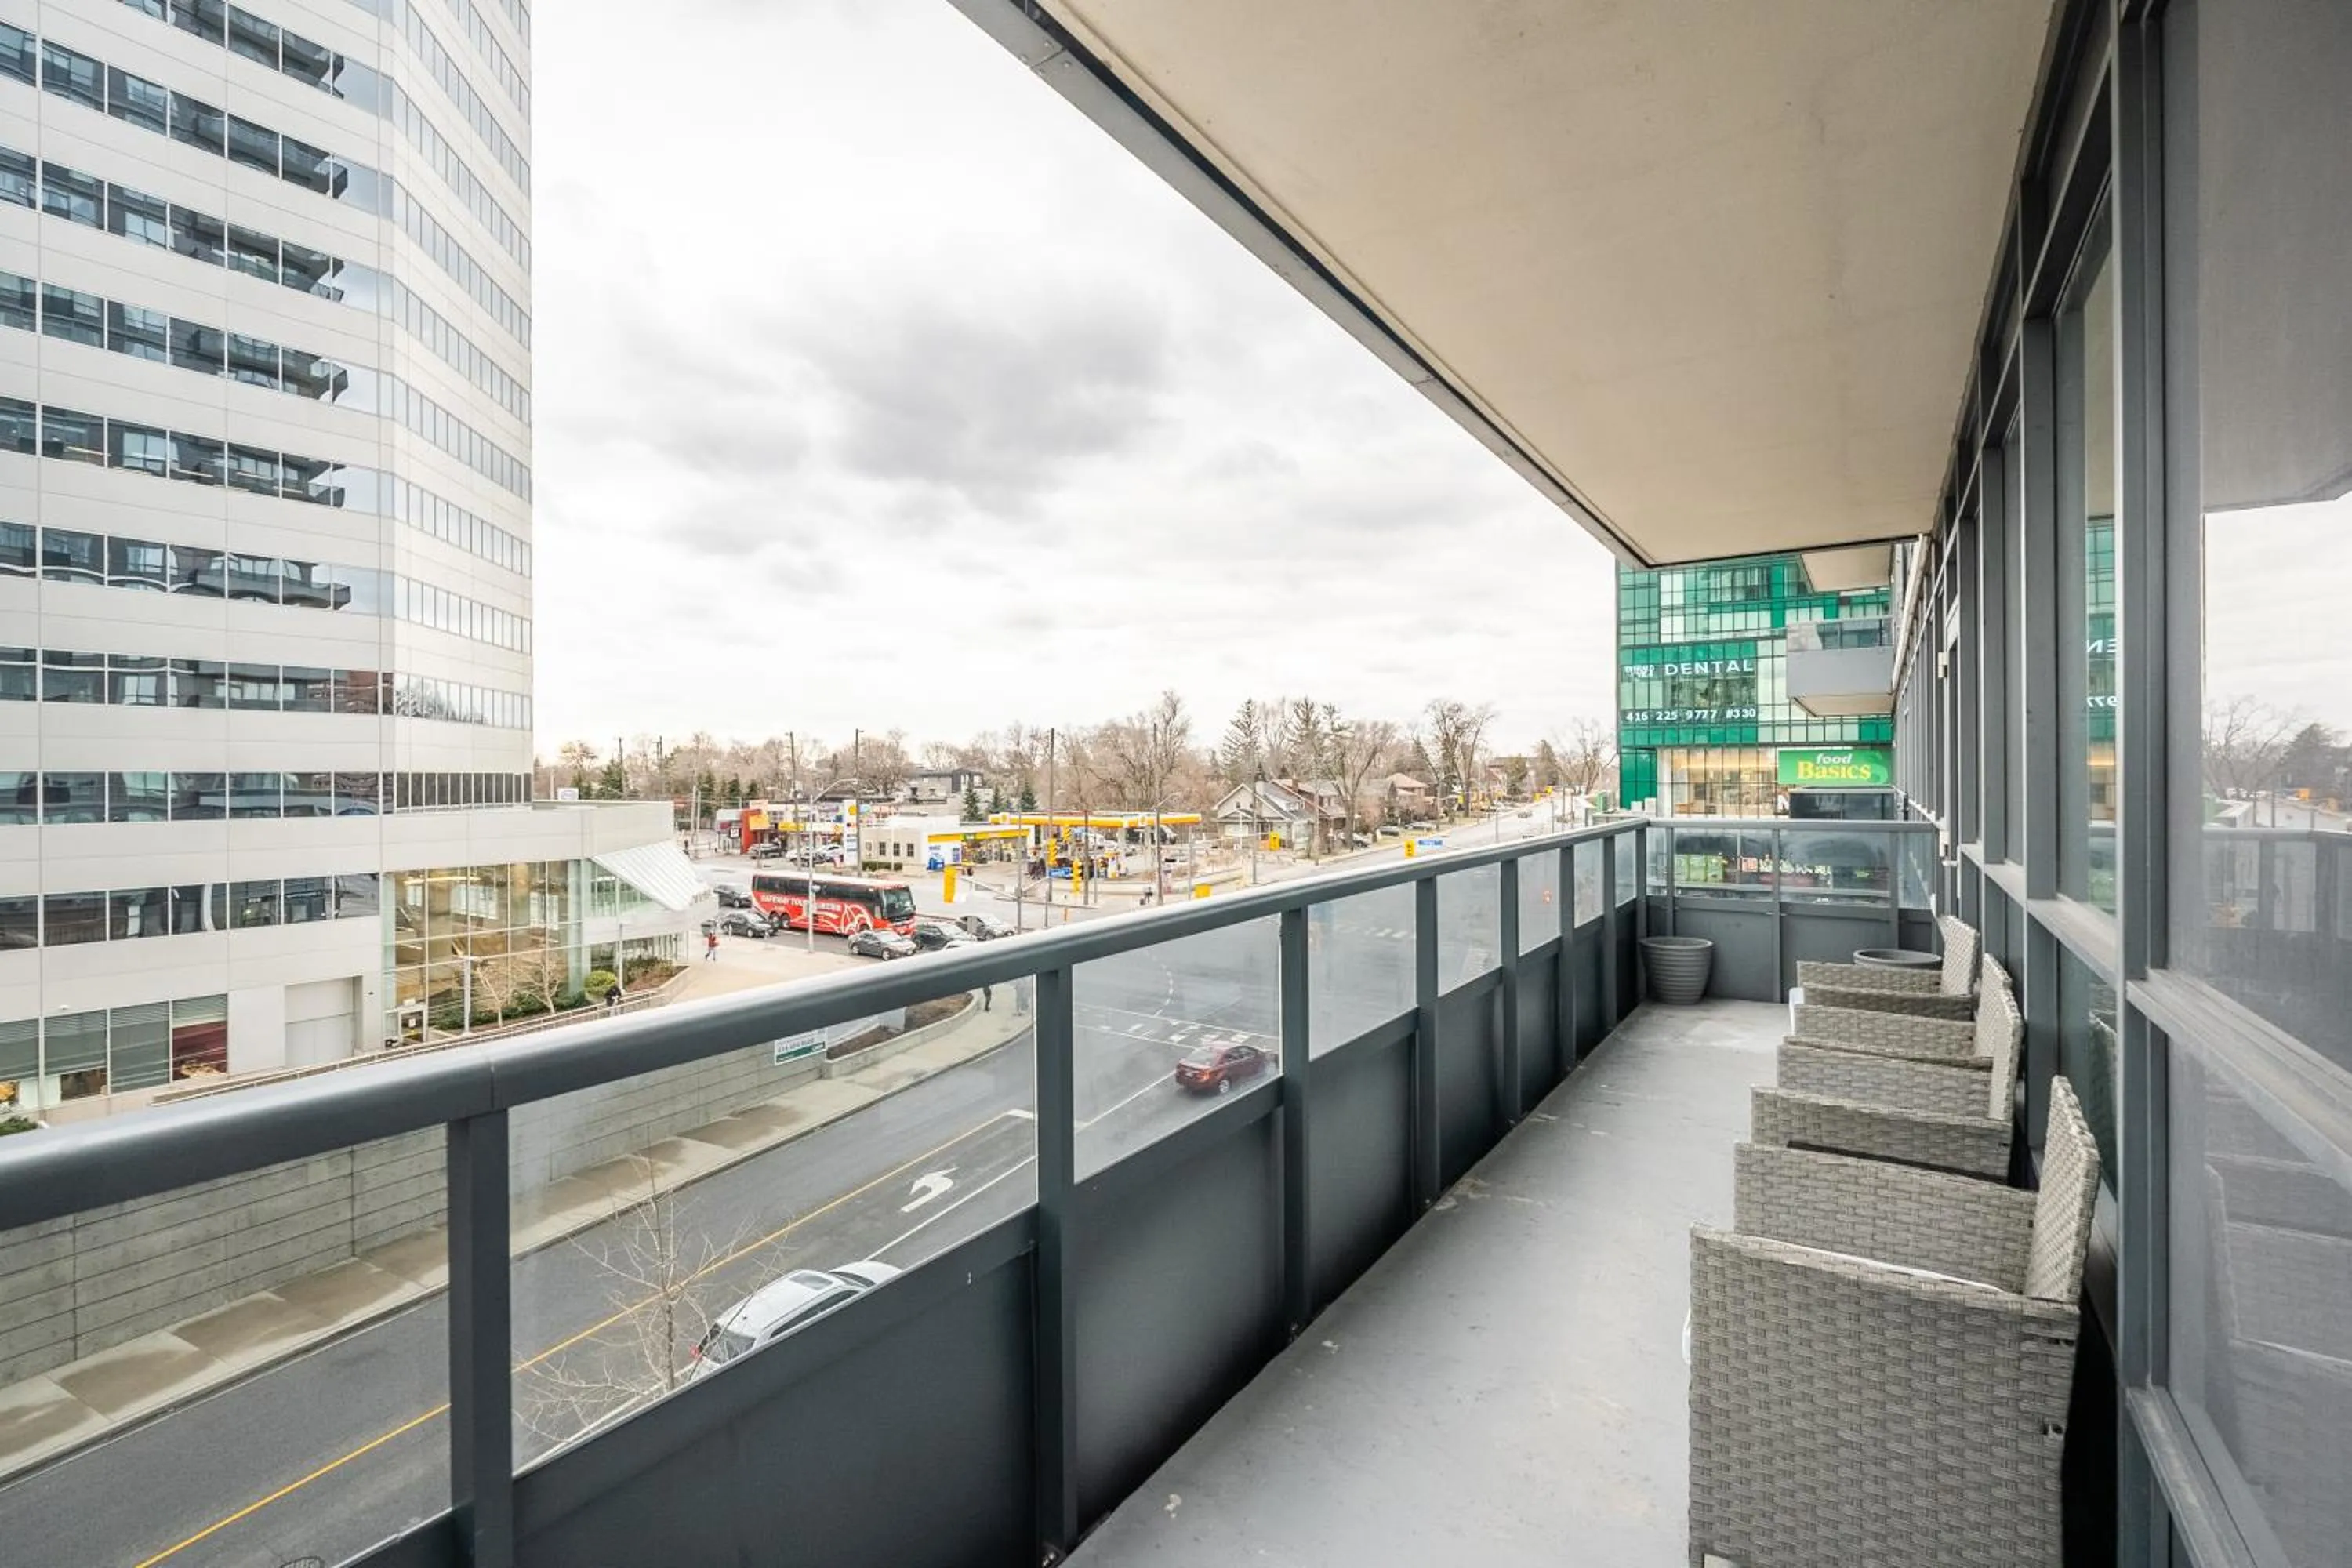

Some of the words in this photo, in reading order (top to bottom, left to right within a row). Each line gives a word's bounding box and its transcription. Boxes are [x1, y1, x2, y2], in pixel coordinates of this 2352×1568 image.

[1664, 659, 1754, 676] DENTAL
[1626, 711, 1649, 722] 416
[1655, 710, 1679, 721] 225
[1686, 710, 1717, 720] 9777
[1816, 753, 1853, 764] food
[1797, 760, 1871, 779] Basics
